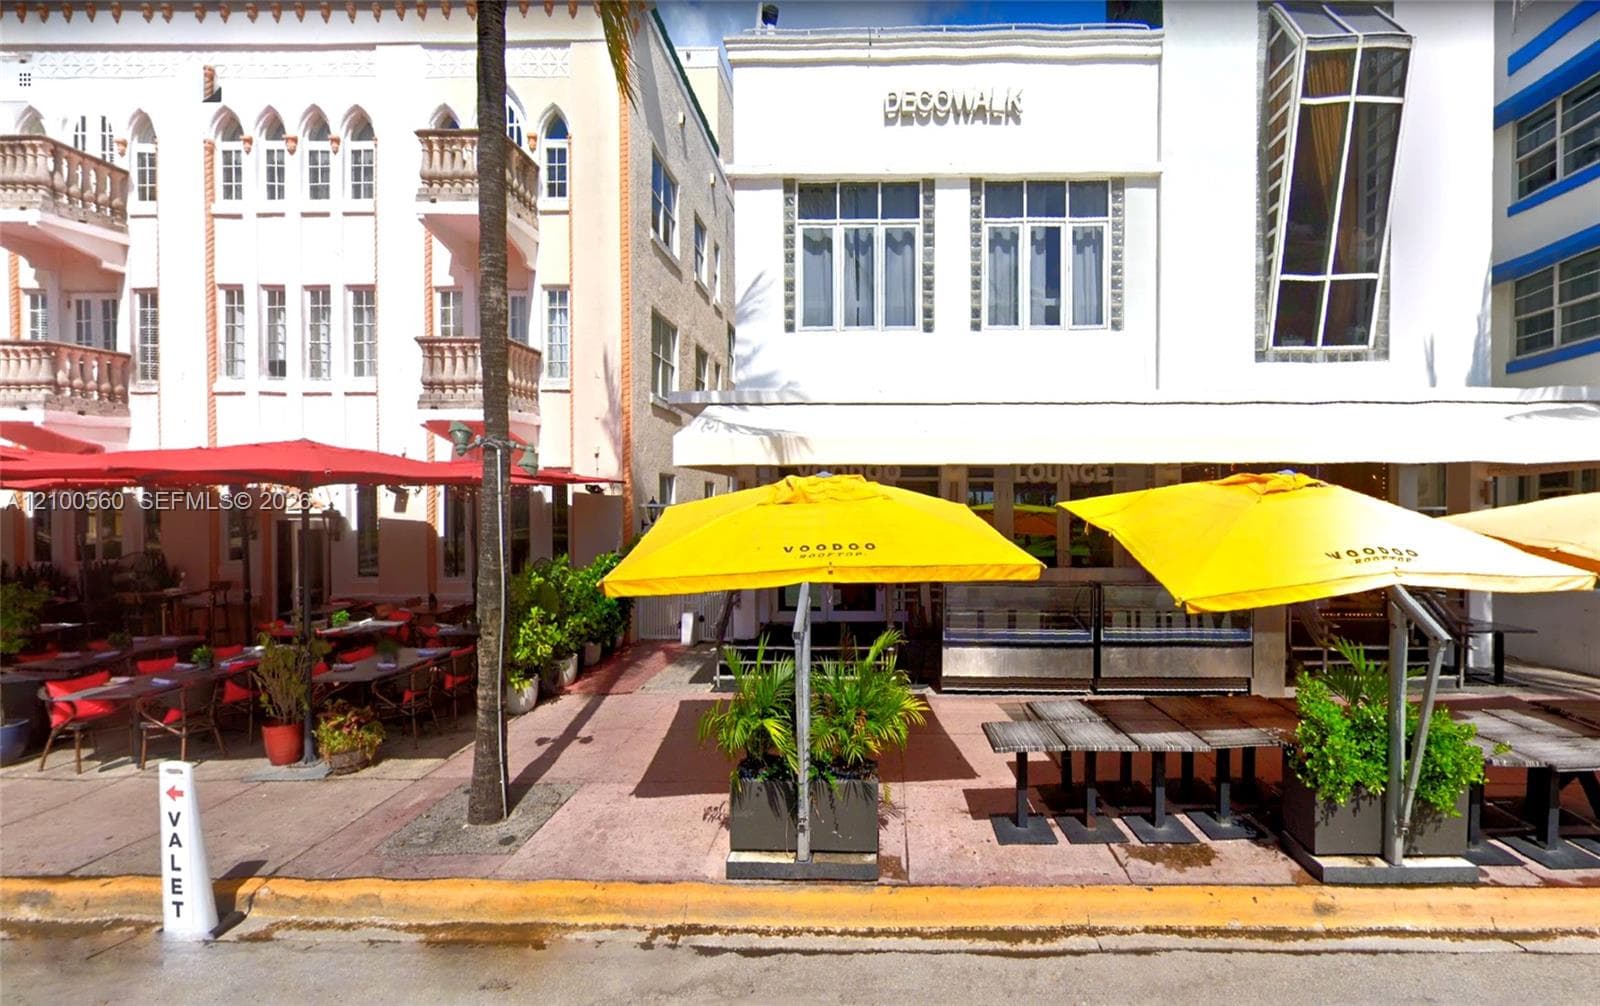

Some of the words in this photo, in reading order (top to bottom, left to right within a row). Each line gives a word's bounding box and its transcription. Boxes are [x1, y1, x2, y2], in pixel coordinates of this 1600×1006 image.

[884, 88, 1023, 126] DECOWALK
[1015, 463, 1110, 483] LOUNGE
[783, 542, 876, 554] VOODOO
[799, 551, 863, 559] ROOFTOP
[1324, 546, 1419, 560] VOODOO
[1354, 555, 1412, 564] ROOFTOP
[168, 811, 184, 918] VALET
